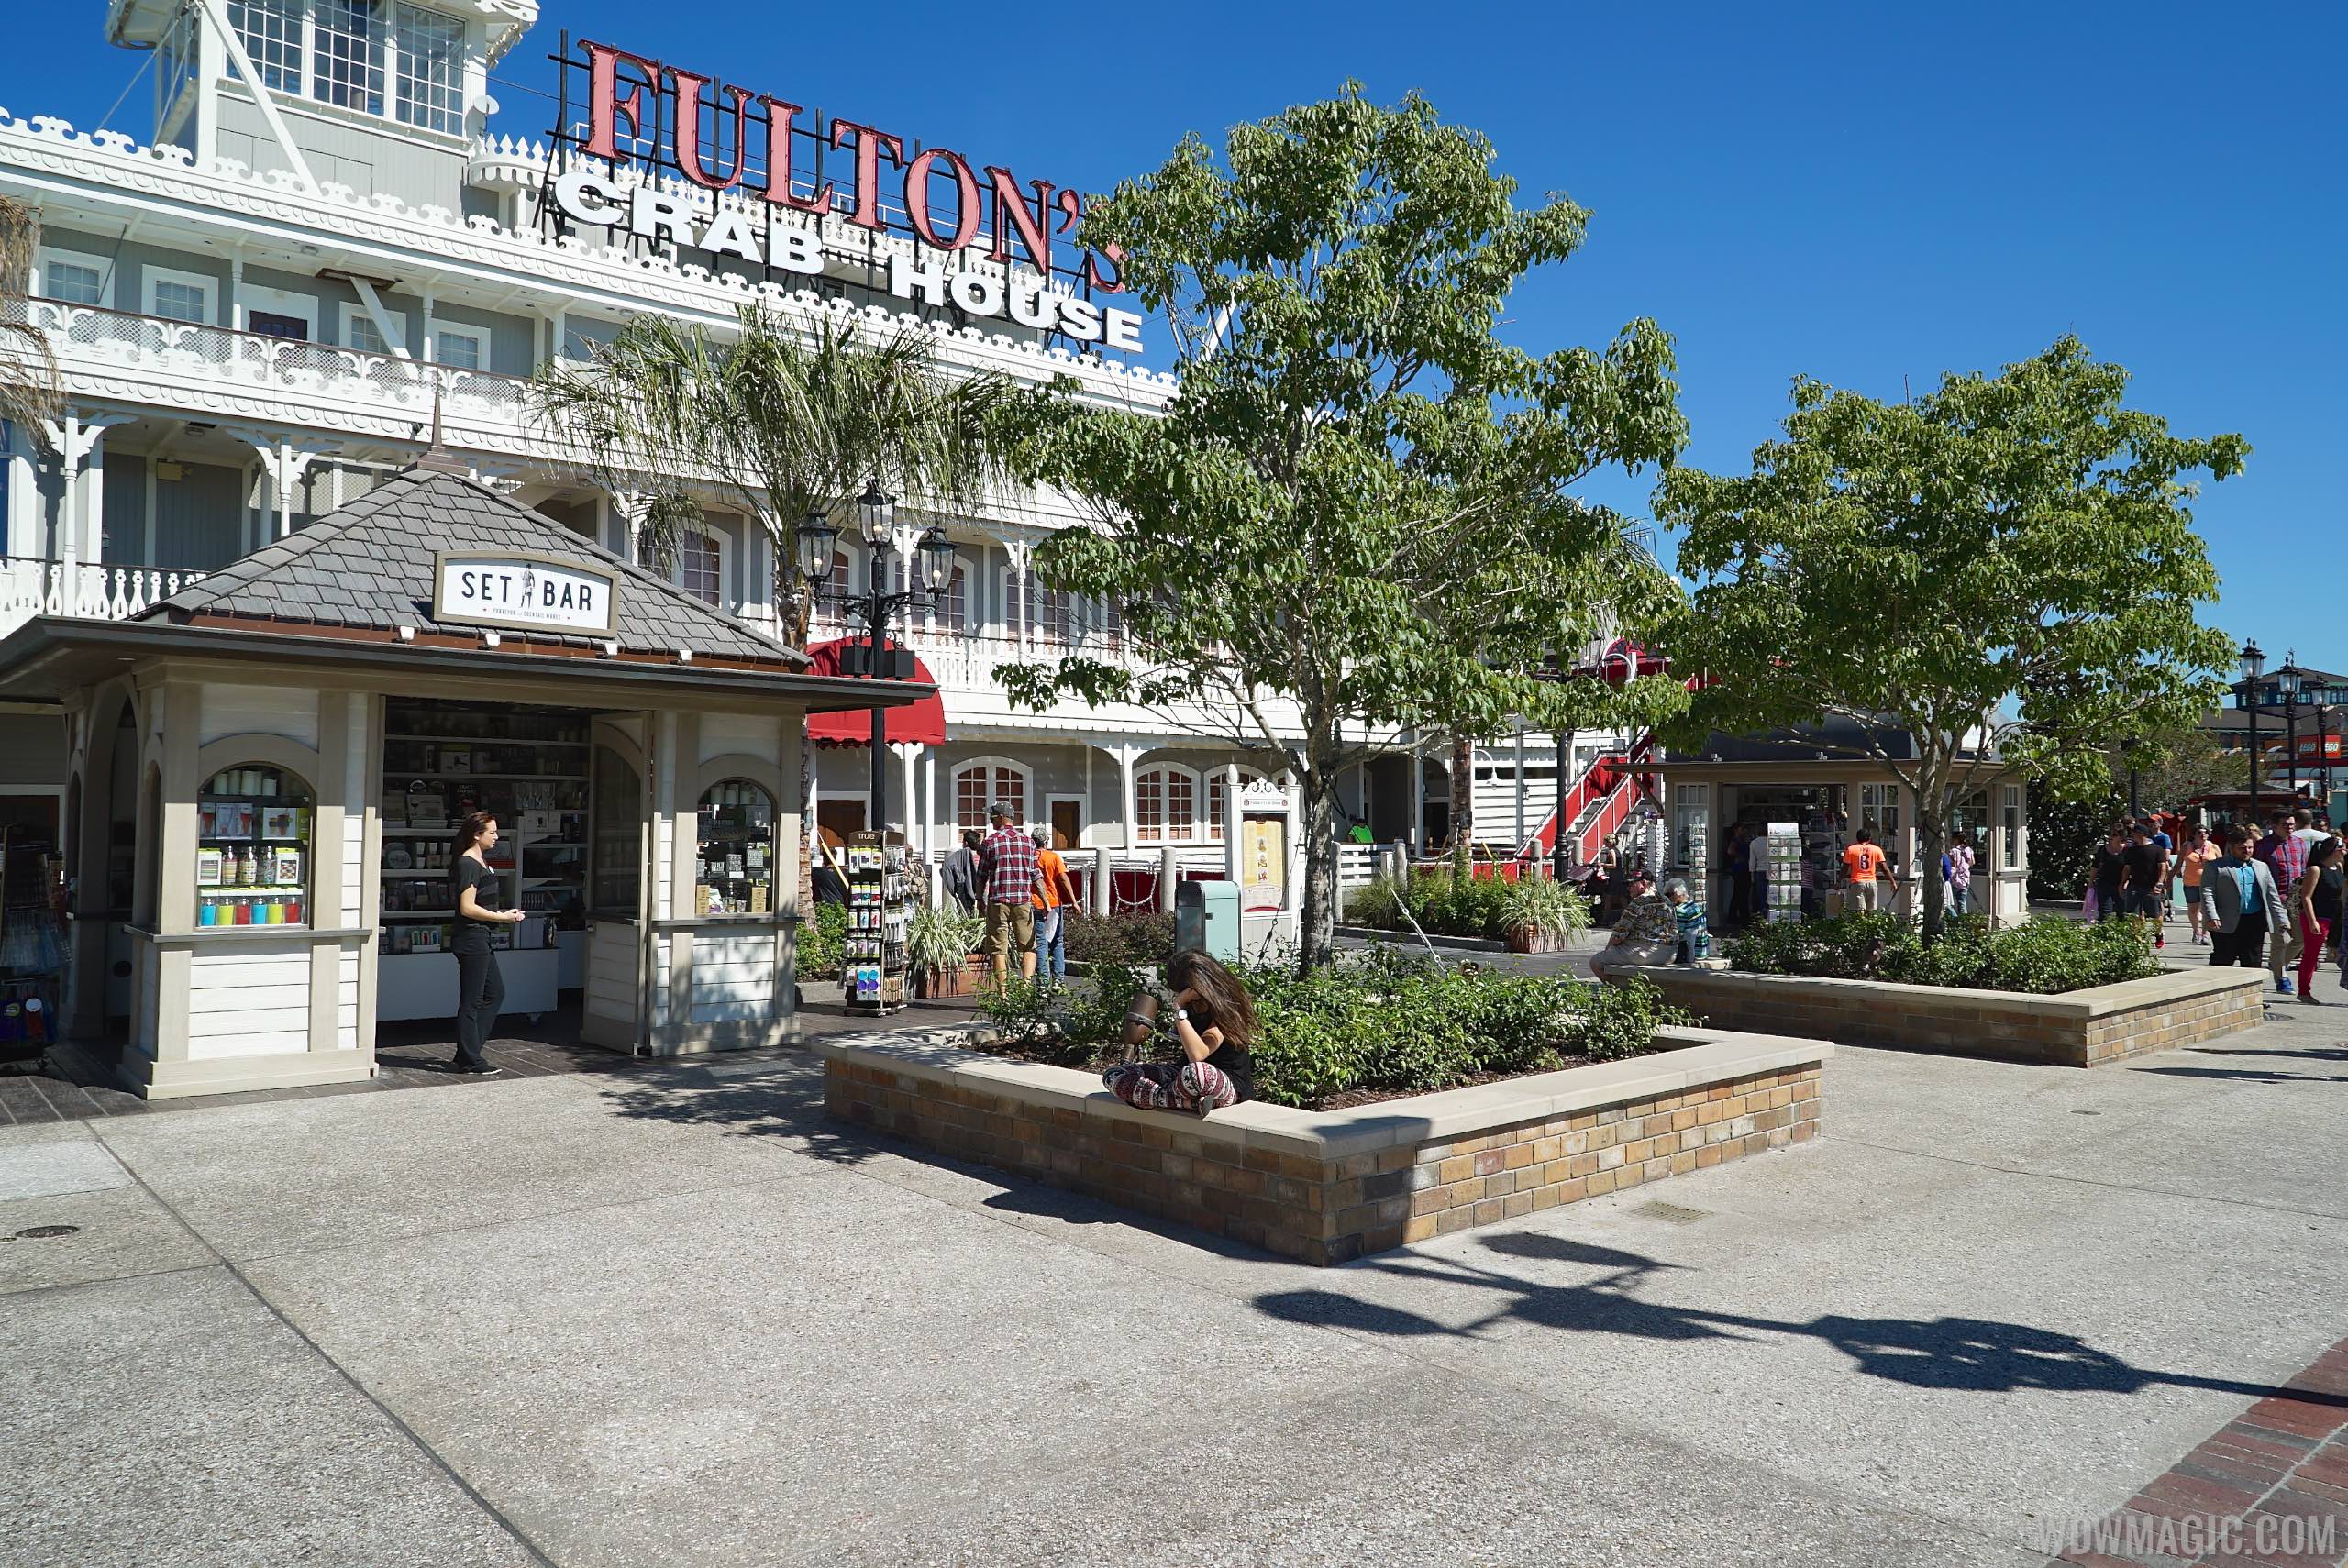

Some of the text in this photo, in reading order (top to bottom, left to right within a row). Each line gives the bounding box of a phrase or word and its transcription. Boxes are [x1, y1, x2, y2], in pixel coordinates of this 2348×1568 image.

[553, 171, 1145, 353] CRAB HOUSE
[461, 571, 592, 611] SET BAR
[2324, 742, 2339, 752] EGO
